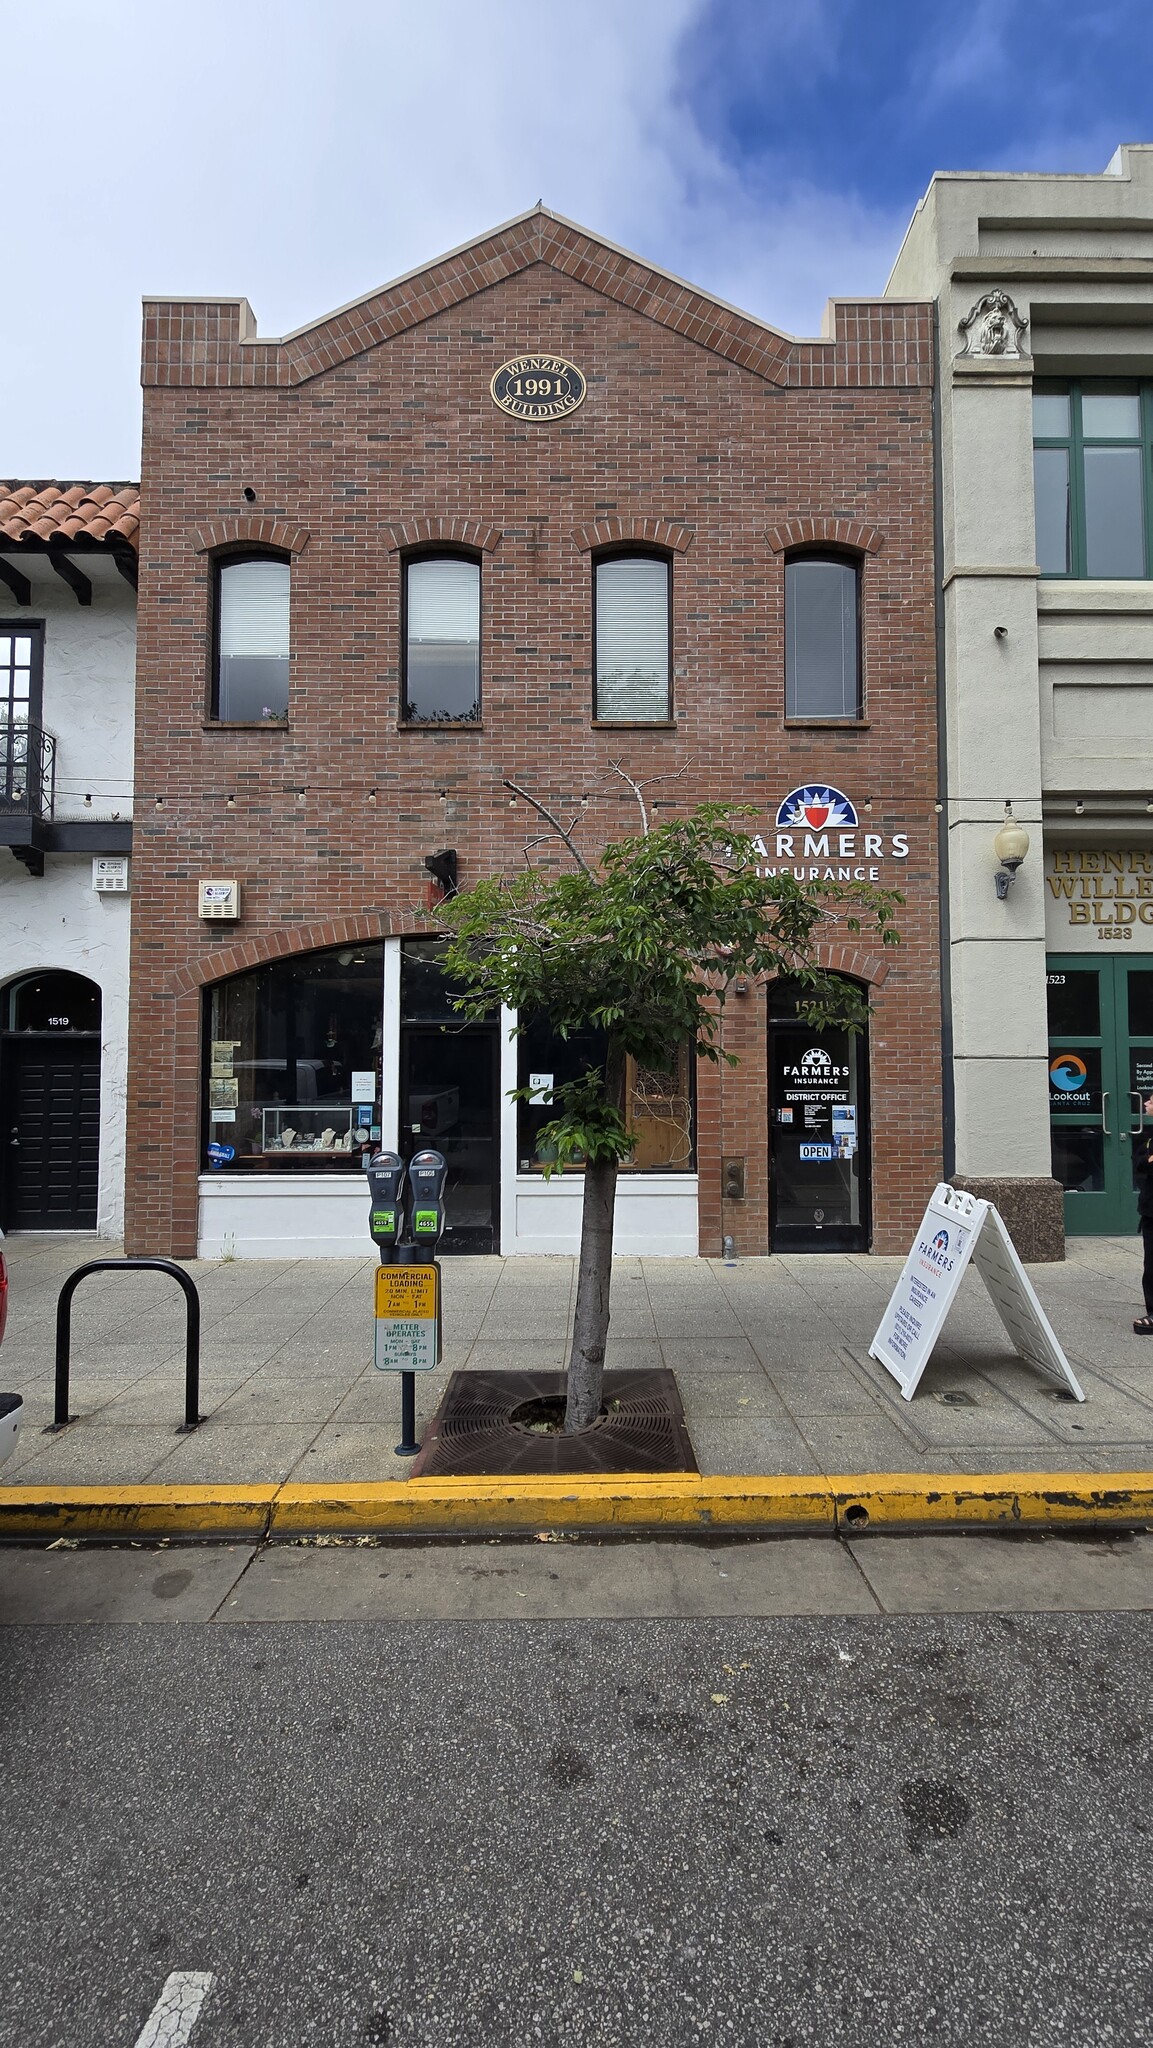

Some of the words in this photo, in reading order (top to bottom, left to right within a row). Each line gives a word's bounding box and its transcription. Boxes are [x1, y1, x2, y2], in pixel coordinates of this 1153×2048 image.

[506, 359, 570, 377] WENZEL
[514, 379, 564, 396] 1991
[501, 394, 576, 416] BUILDING
[1098, 928, 1132, 940] 1523
[1046, 975, 1066, 984] 1523
[47, 1017, 69, 1026] 1519
[783, 1066, 850, 1076] FARMERS
[786, 1093, 820, 1101] DISTRICT
[820, 1093, 847, 1101] OFFICE
[1049, 1092, 1091, 1101] Lookout
[803, 1146, 829, 1157] OPEN
[919, 1242, 954, 1271] FARMERS
[919, 1259, 942, 1278] INSURANCE
